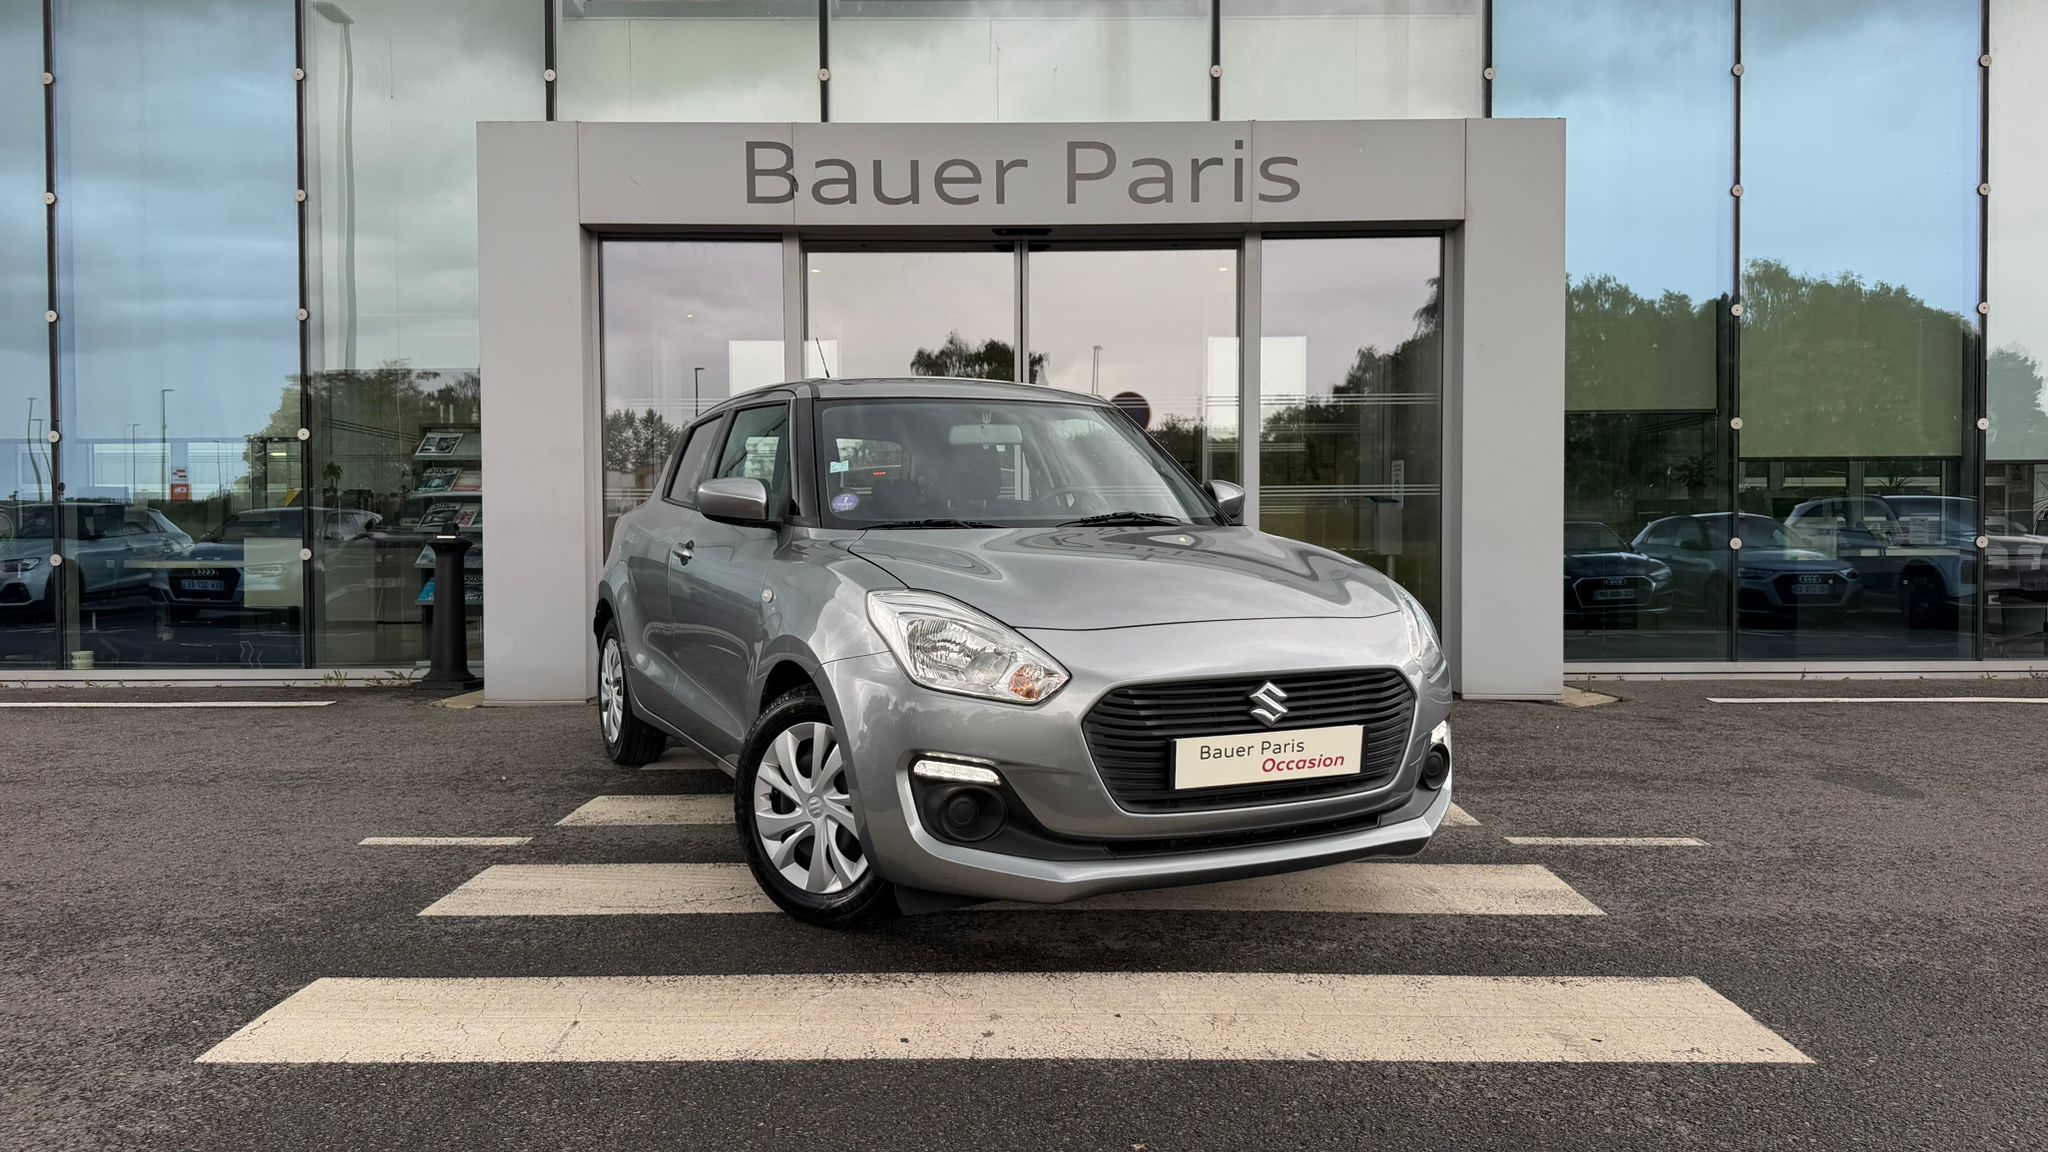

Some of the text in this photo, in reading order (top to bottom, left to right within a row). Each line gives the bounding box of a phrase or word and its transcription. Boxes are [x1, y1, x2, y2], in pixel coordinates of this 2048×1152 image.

[745, 139, 1302, 205] Bauer Paris
[1200, 739, 1305, 760] Bauer Paris
[1262, 754, 1345, 773] Occasion
